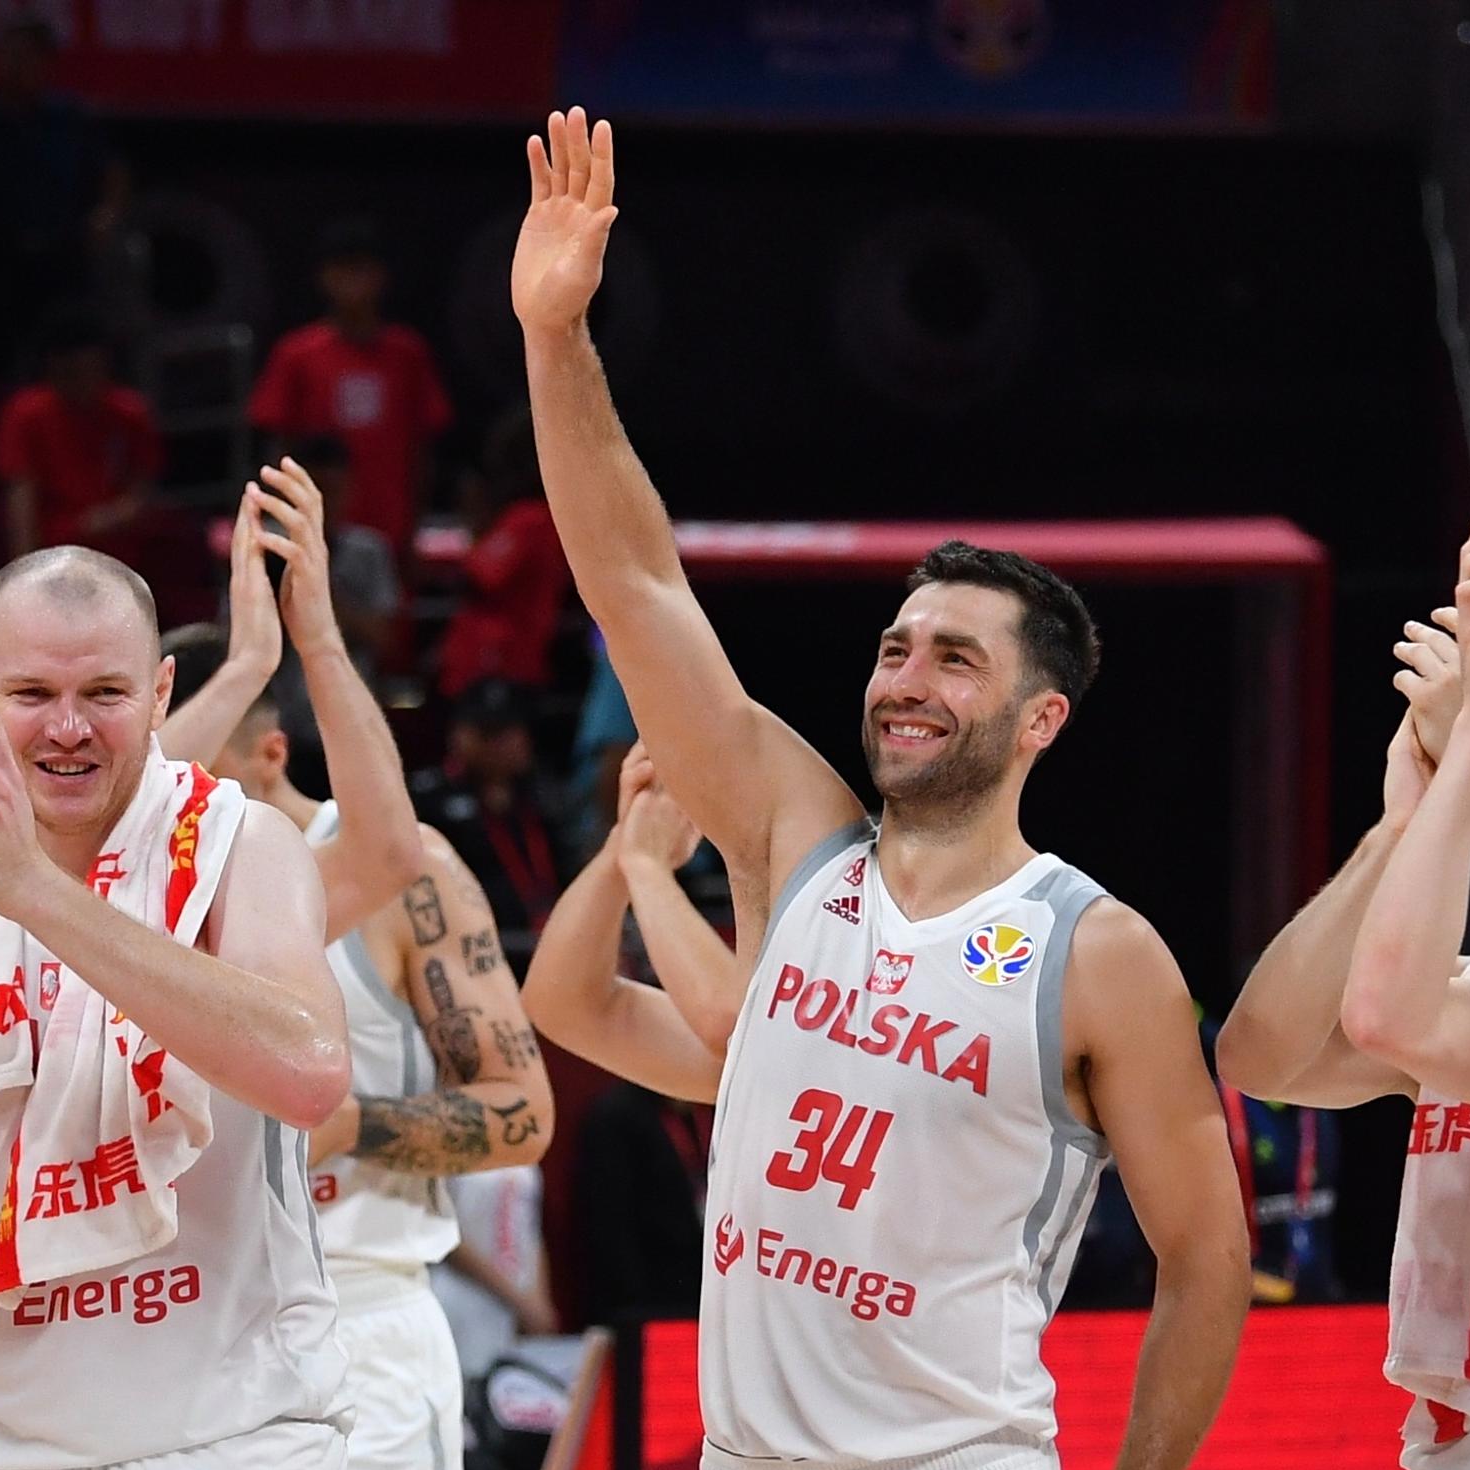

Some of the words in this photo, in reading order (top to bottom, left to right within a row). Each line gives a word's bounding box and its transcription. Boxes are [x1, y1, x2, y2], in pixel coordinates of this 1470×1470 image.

[767, 963, 992, 1098] POLSKA
[765, 1088, 894, 1211] 34
[13, 1265, 201, 1325] Energa
[756, 1228, 917, 1321] Energa
